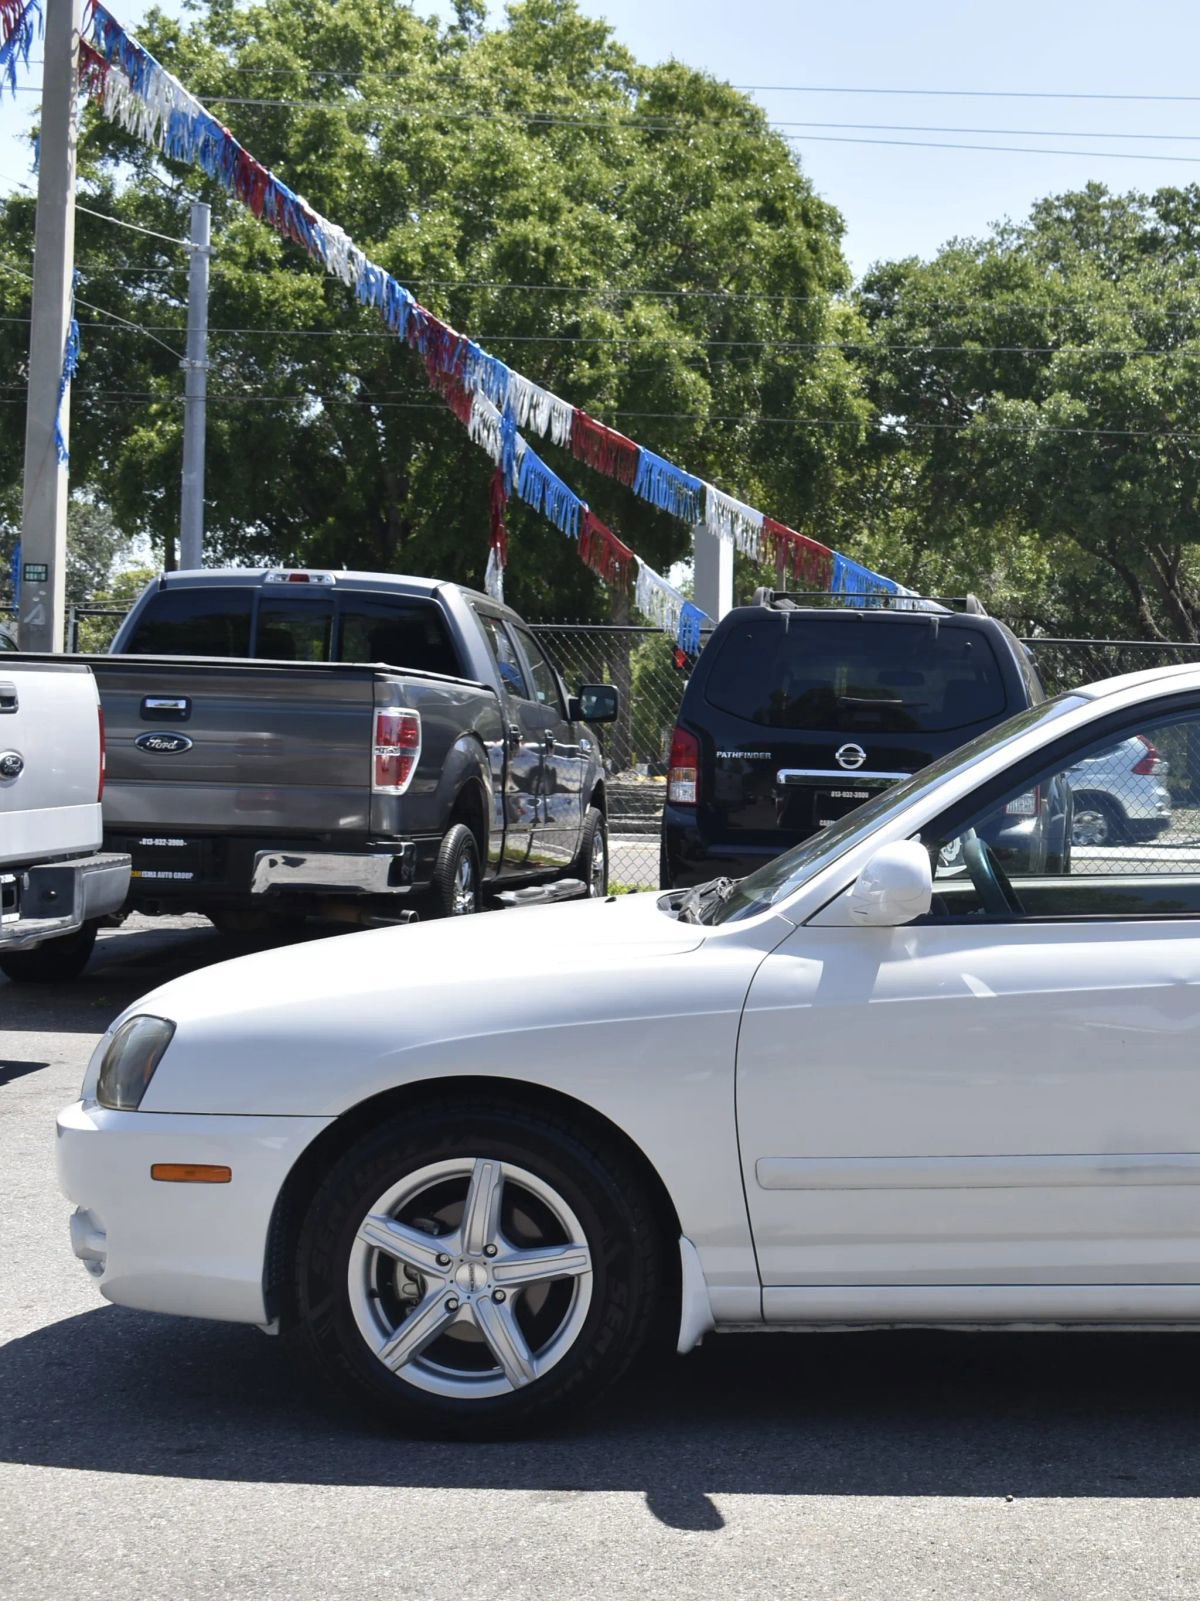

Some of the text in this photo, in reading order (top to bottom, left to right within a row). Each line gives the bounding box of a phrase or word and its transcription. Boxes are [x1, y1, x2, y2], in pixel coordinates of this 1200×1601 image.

[145, 736, 178, 749] Ford
[716, 751, 772, 759] PATHFINDER
[157, 871, 173, 879] AUTO
[173, 872, 194, 880] GROUP
